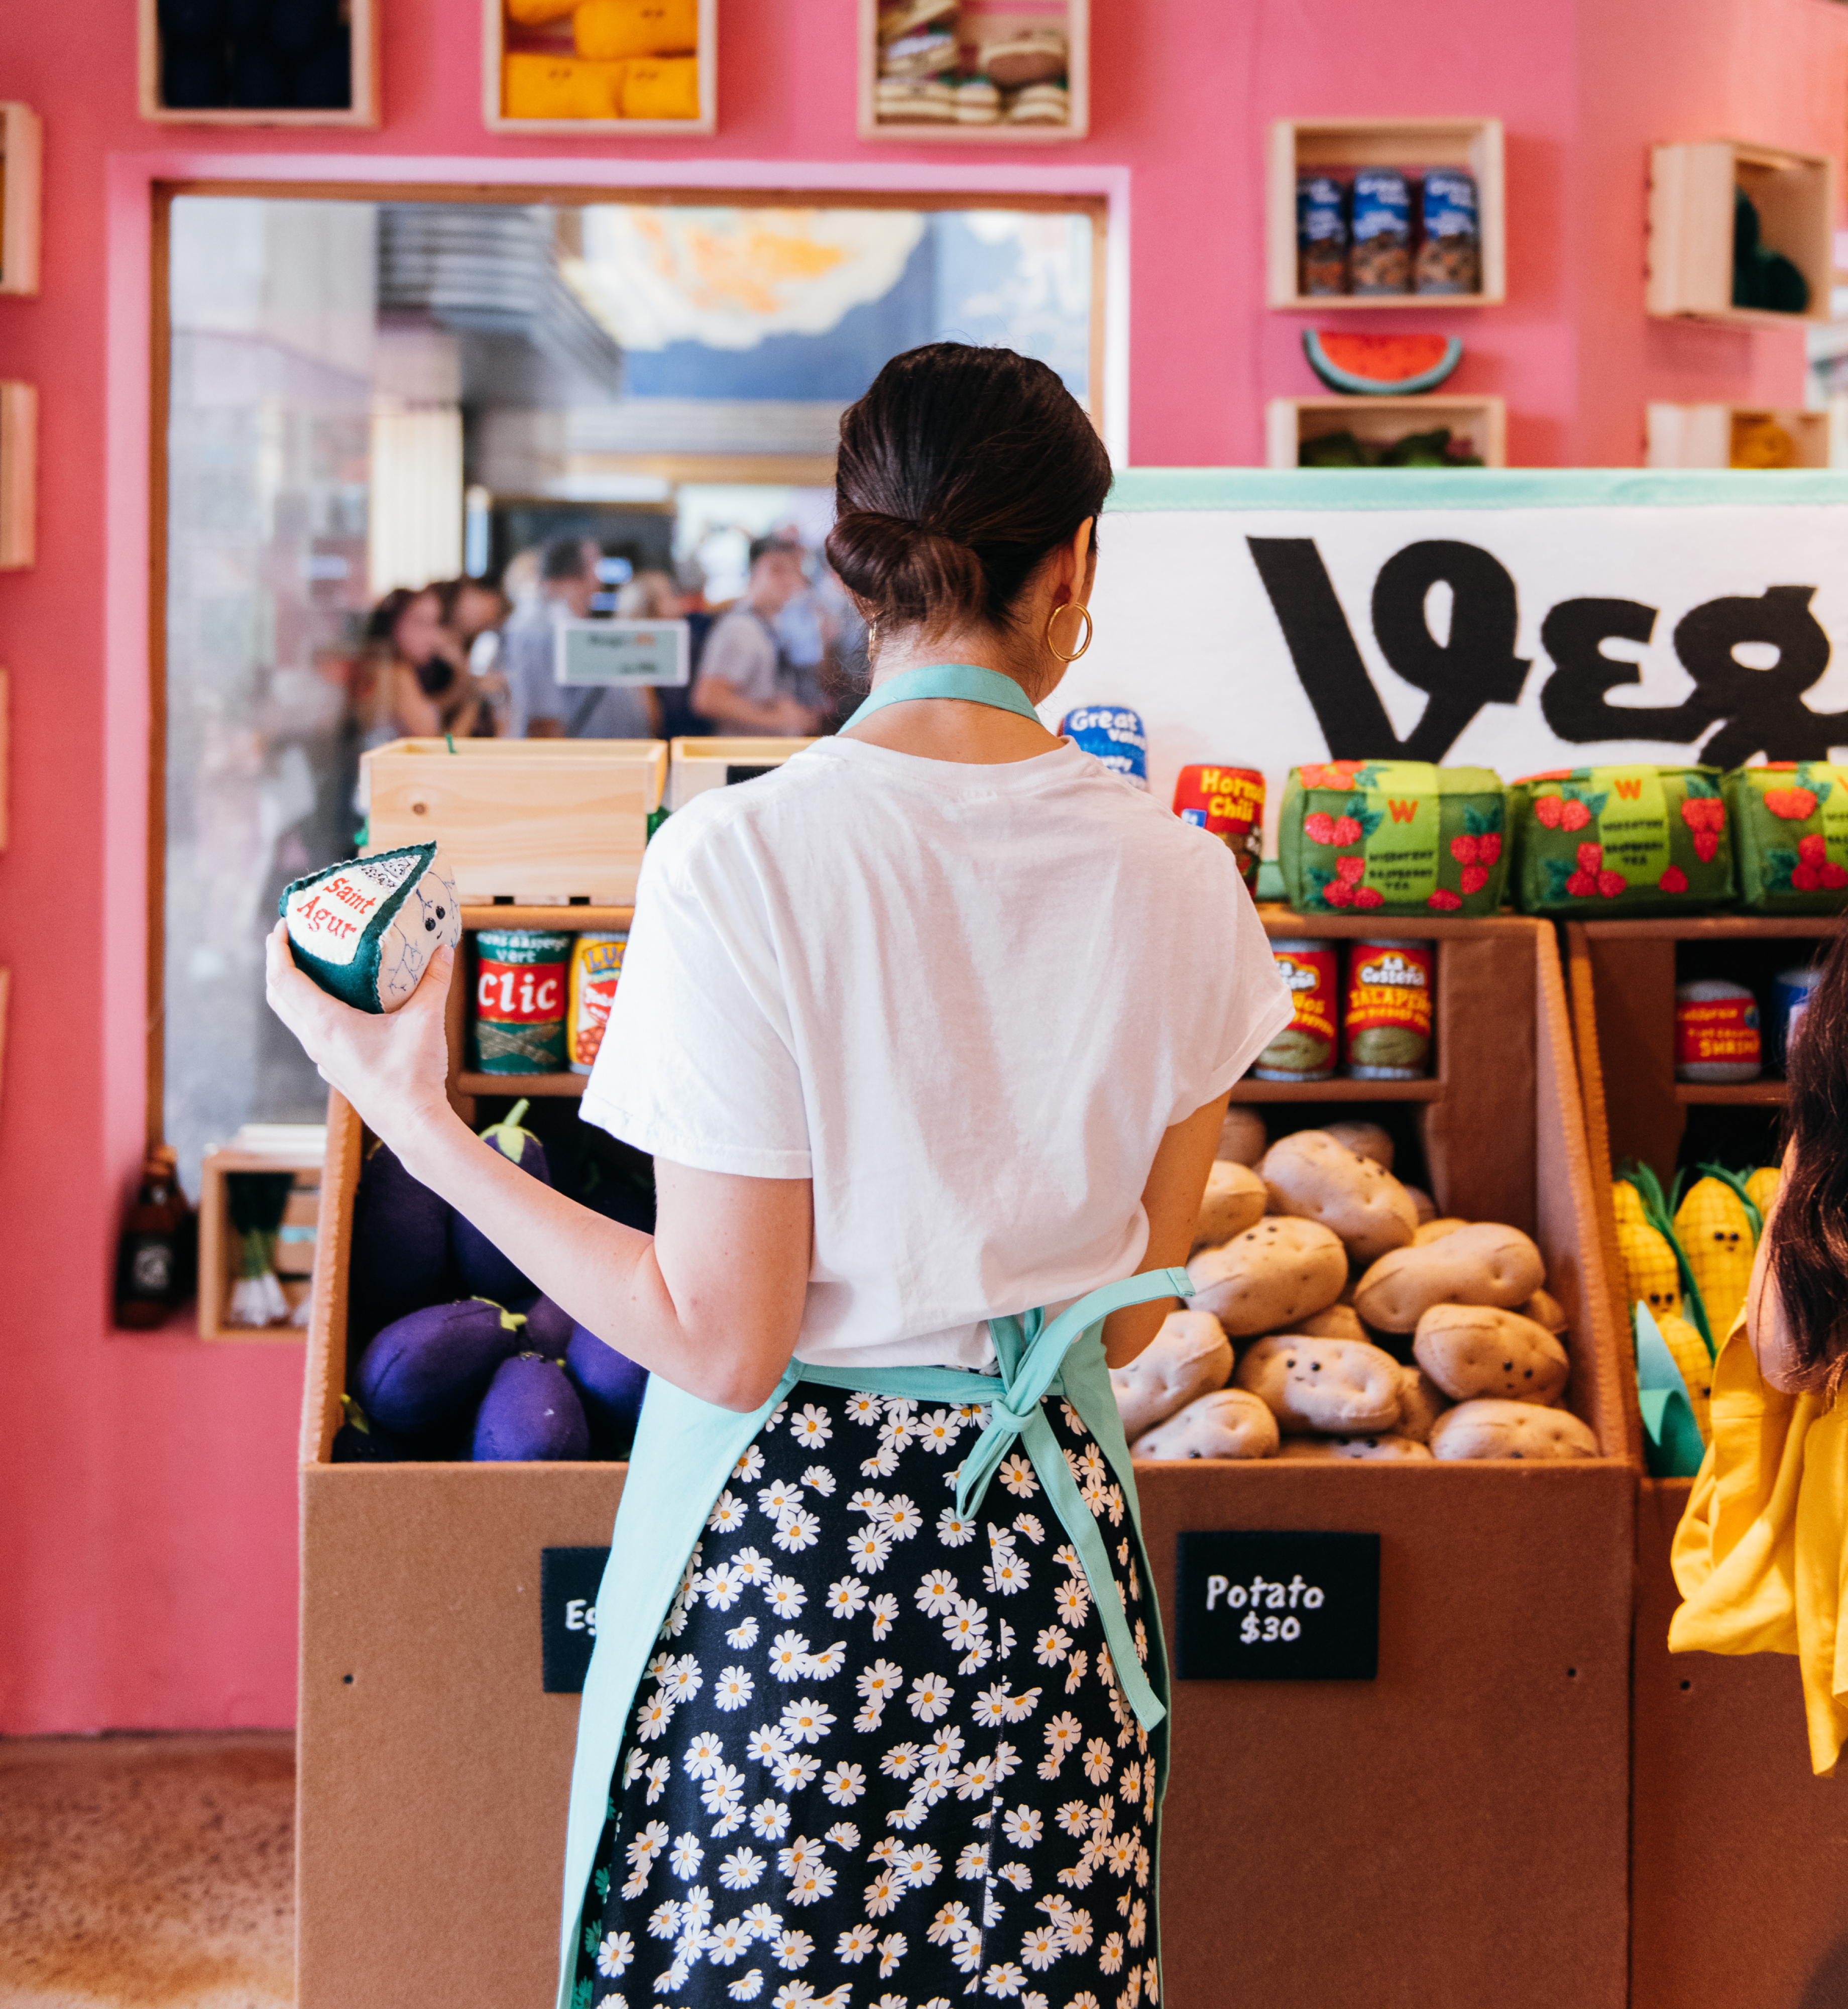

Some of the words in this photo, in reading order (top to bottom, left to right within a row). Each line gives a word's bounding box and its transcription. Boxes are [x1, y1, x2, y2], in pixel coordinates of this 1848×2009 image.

[1071, 710, 1137, 731] Great
[1614, 778, 1641, 800] W
[1208, 795, 1253, 822] Chili
[1388, 799, 1418, 823] W
[322, 877, 376, 914] Saint
[1385, 881, 1410, 890] TEA
[297, 896, 357, 939] Agur
[1207, 1574, 1325, 1611] Potato
[1240, 1610, 1301, 1644] $30
